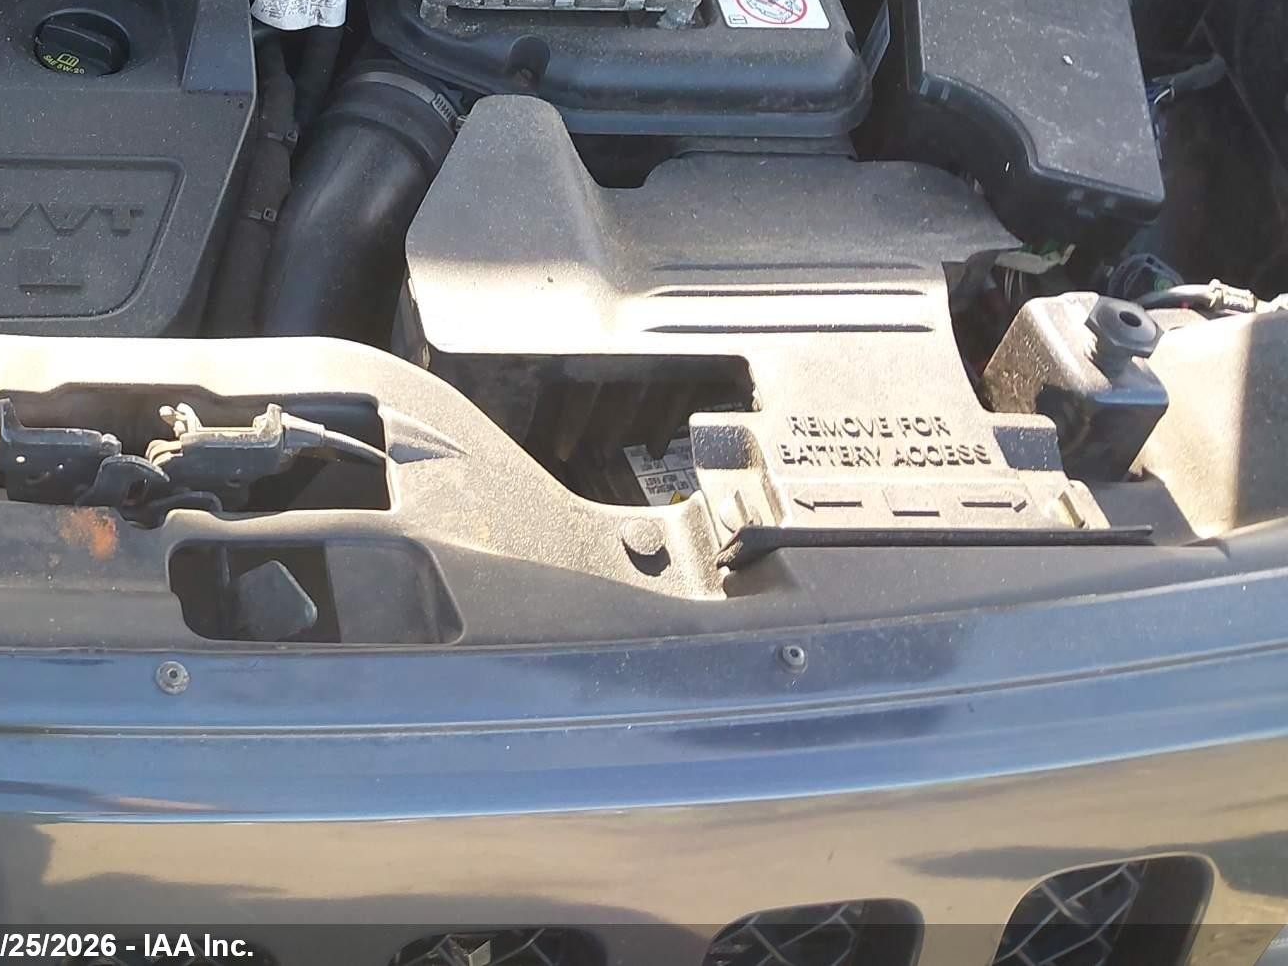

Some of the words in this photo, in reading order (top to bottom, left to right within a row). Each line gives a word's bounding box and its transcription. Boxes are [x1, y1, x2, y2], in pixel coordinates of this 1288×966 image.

[43, 54, 58, 66] SAE
[57, 64, 85, 74] 5W-20
[787, 416, 894, 438] REMOVE
[896, 416, 952, 438] FOR
[777, 444, 882, 467] BATTERY
[894, 444, 992, 468] ACCESS
